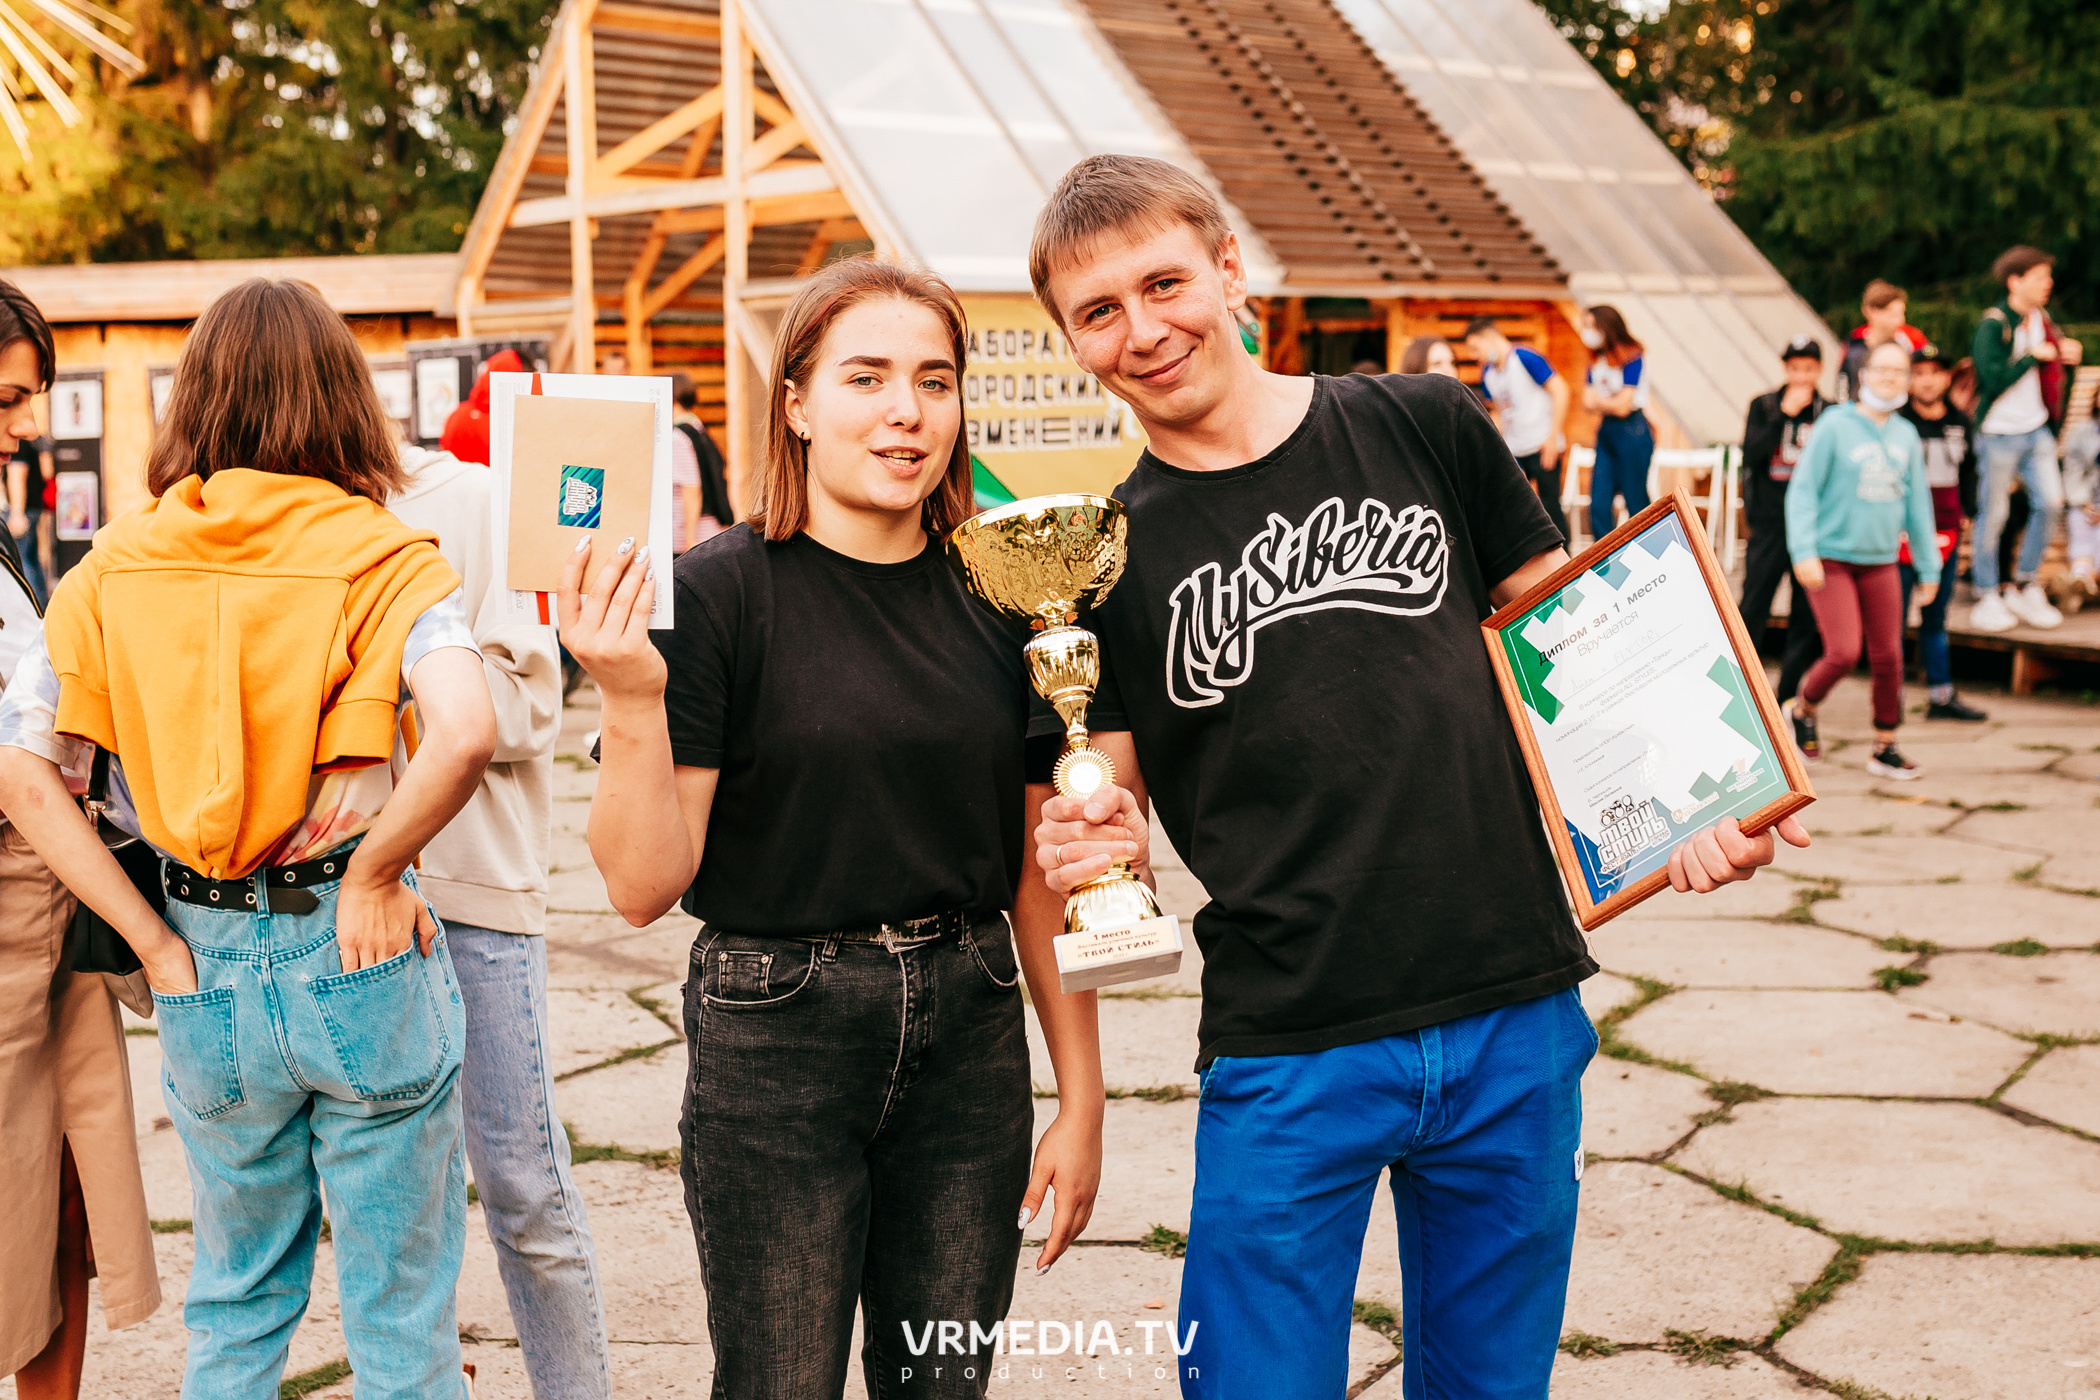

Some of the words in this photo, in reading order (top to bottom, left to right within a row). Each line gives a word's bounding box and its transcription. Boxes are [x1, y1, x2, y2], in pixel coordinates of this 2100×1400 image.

[1166, 497, 1449, 708] MySiberia
[1537, 627, 1586, 666] Диплом
[1592, 613, 1608, 627] за
[1612, 602, 1620, 612] 1
[1627, 573, 1666, 604] место
[1577, 611, 1638, 656] Вручается
[1101, 930, 1131, 939] место
